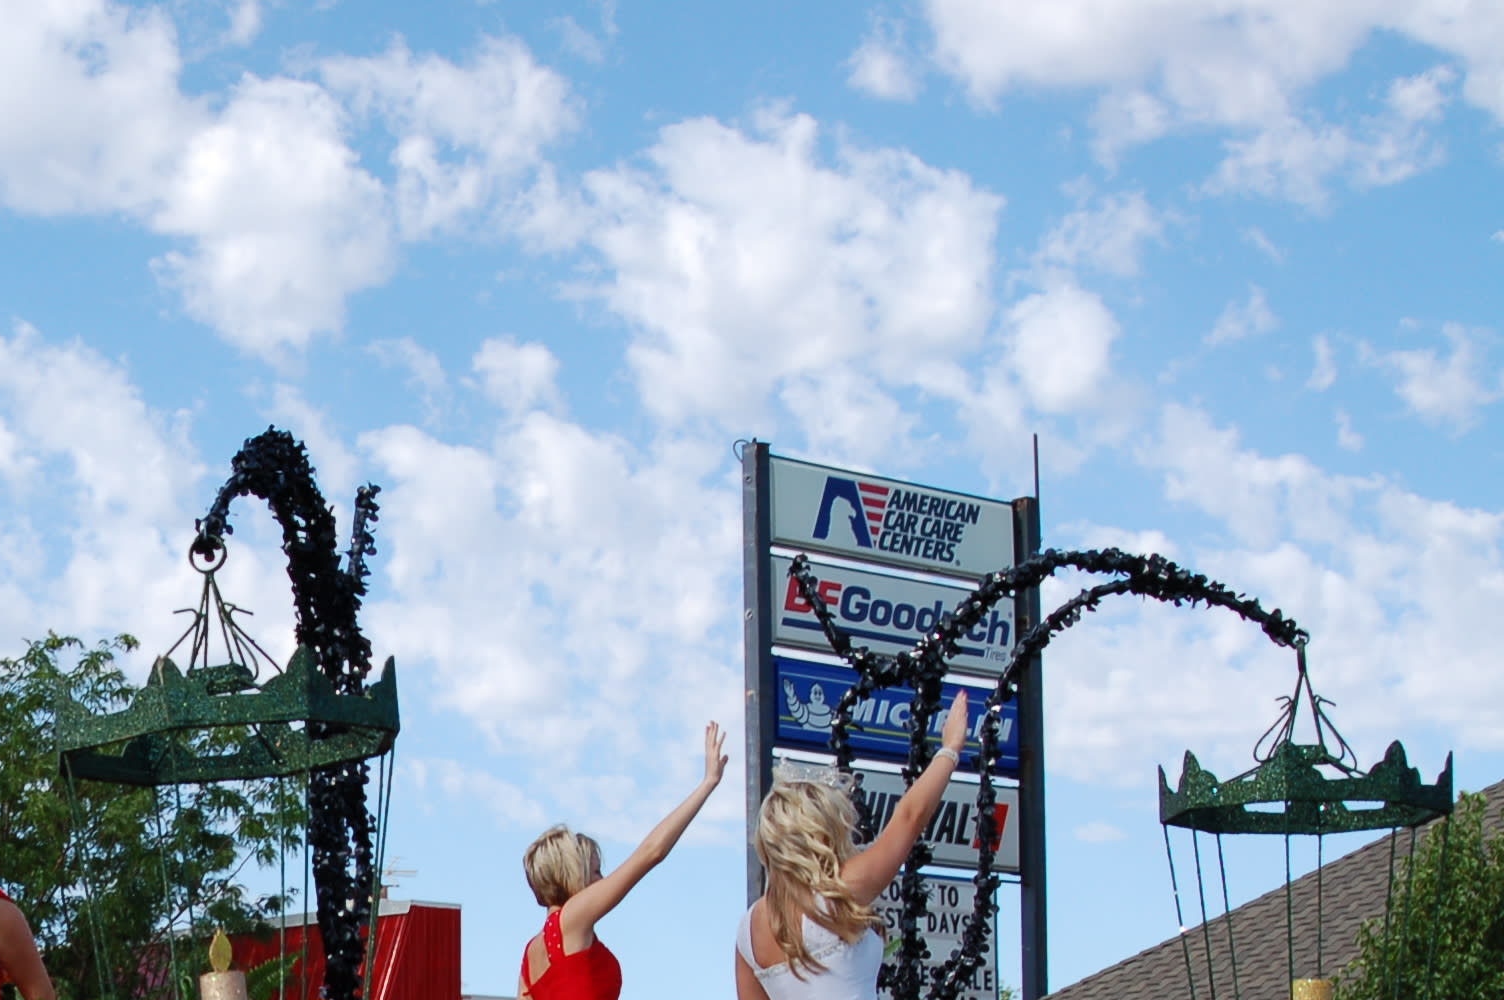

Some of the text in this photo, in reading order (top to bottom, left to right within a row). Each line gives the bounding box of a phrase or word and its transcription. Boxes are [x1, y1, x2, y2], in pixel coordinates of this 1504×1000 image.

[887, 489, 981, 525] AMERICAN
[883, 510, 965, 543] CAR CARE
[878, 531, 956, 563] CENTERS
[783, 576, 1011, 647] BFGoodch
[938, 885, 959, 908] TO
[927, 912, 972, 934] DAYS
